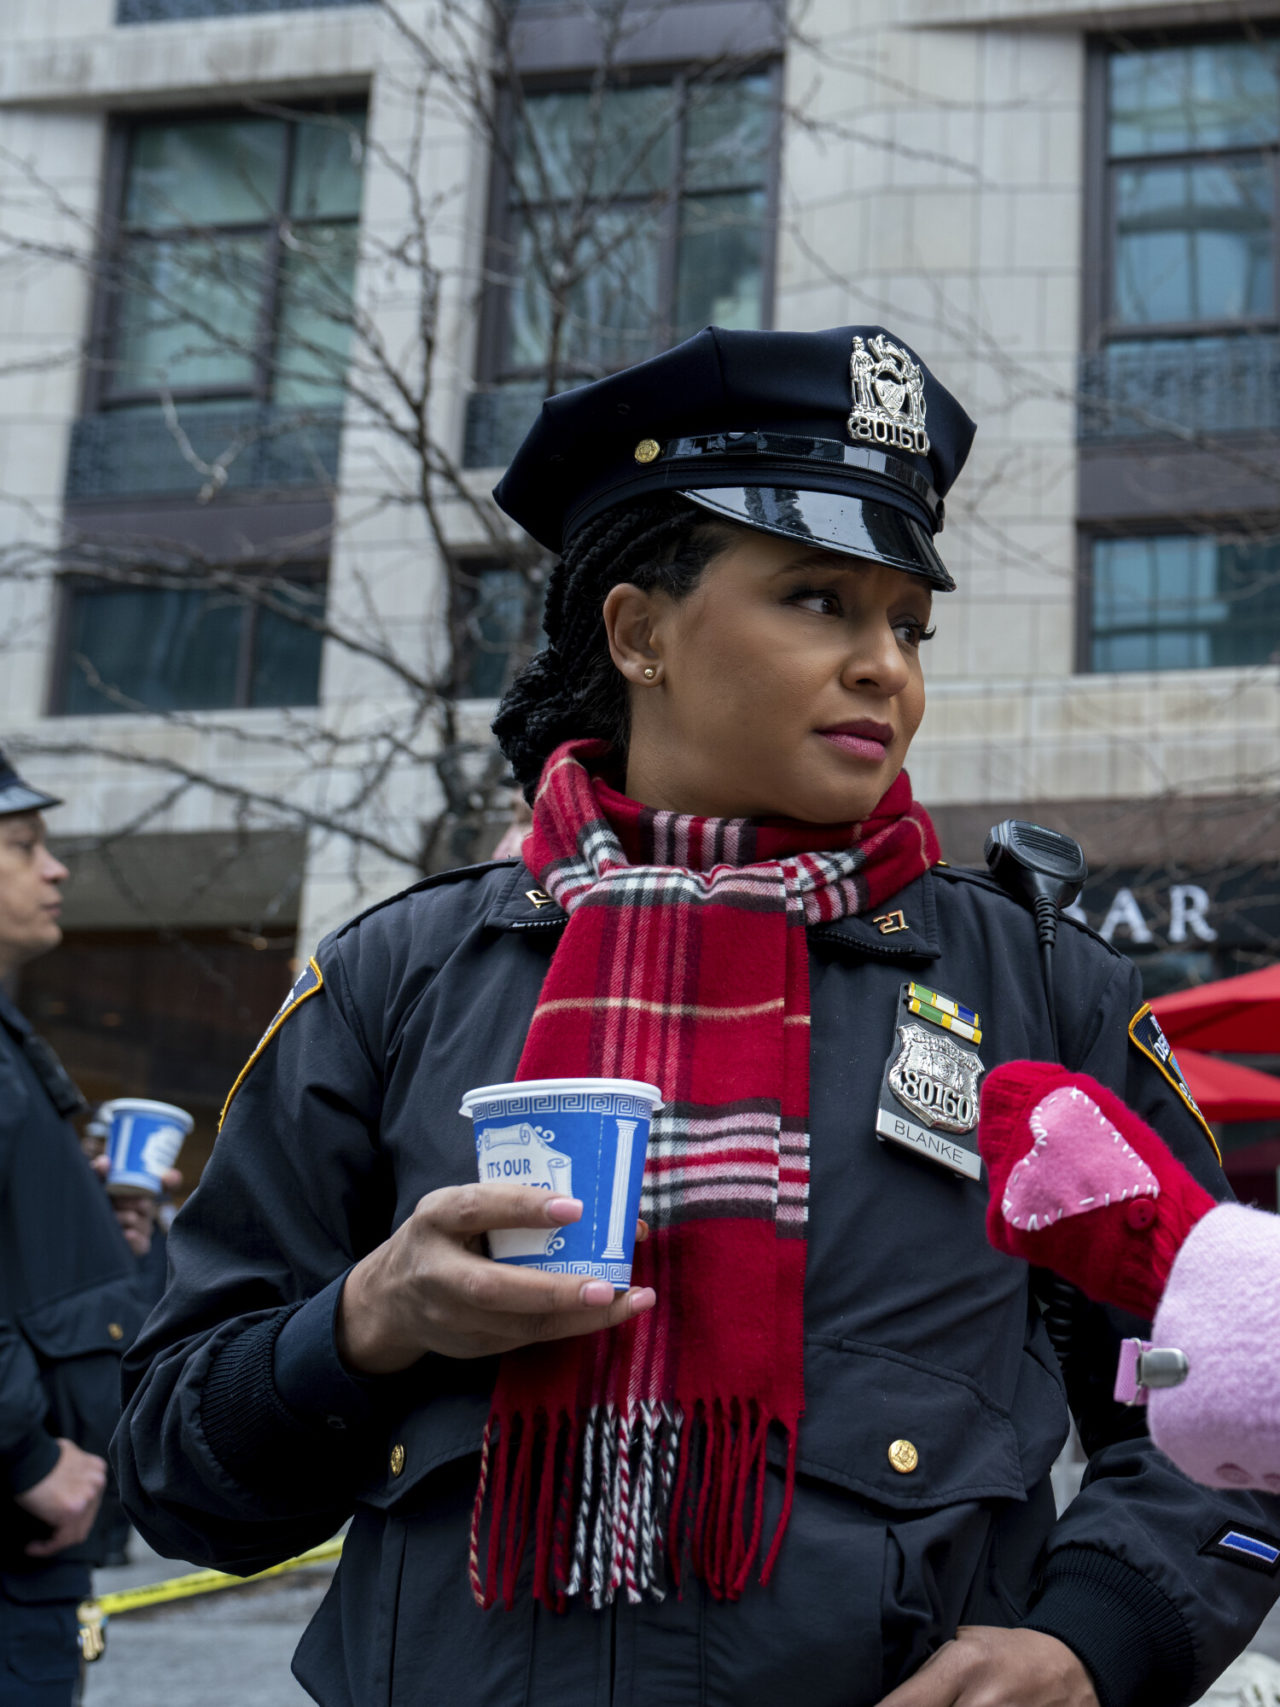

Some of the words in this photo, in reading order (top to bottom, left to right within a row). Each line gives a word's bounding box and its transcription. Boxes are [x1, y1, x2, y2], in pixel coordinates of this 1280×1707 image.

[854, 414, 930, 455] 80160
[903, 1070, 974, 1124] 80160
[894, 1119, 963, 1165] BLANKE
[503, 1158, 531, 1176] OUR
